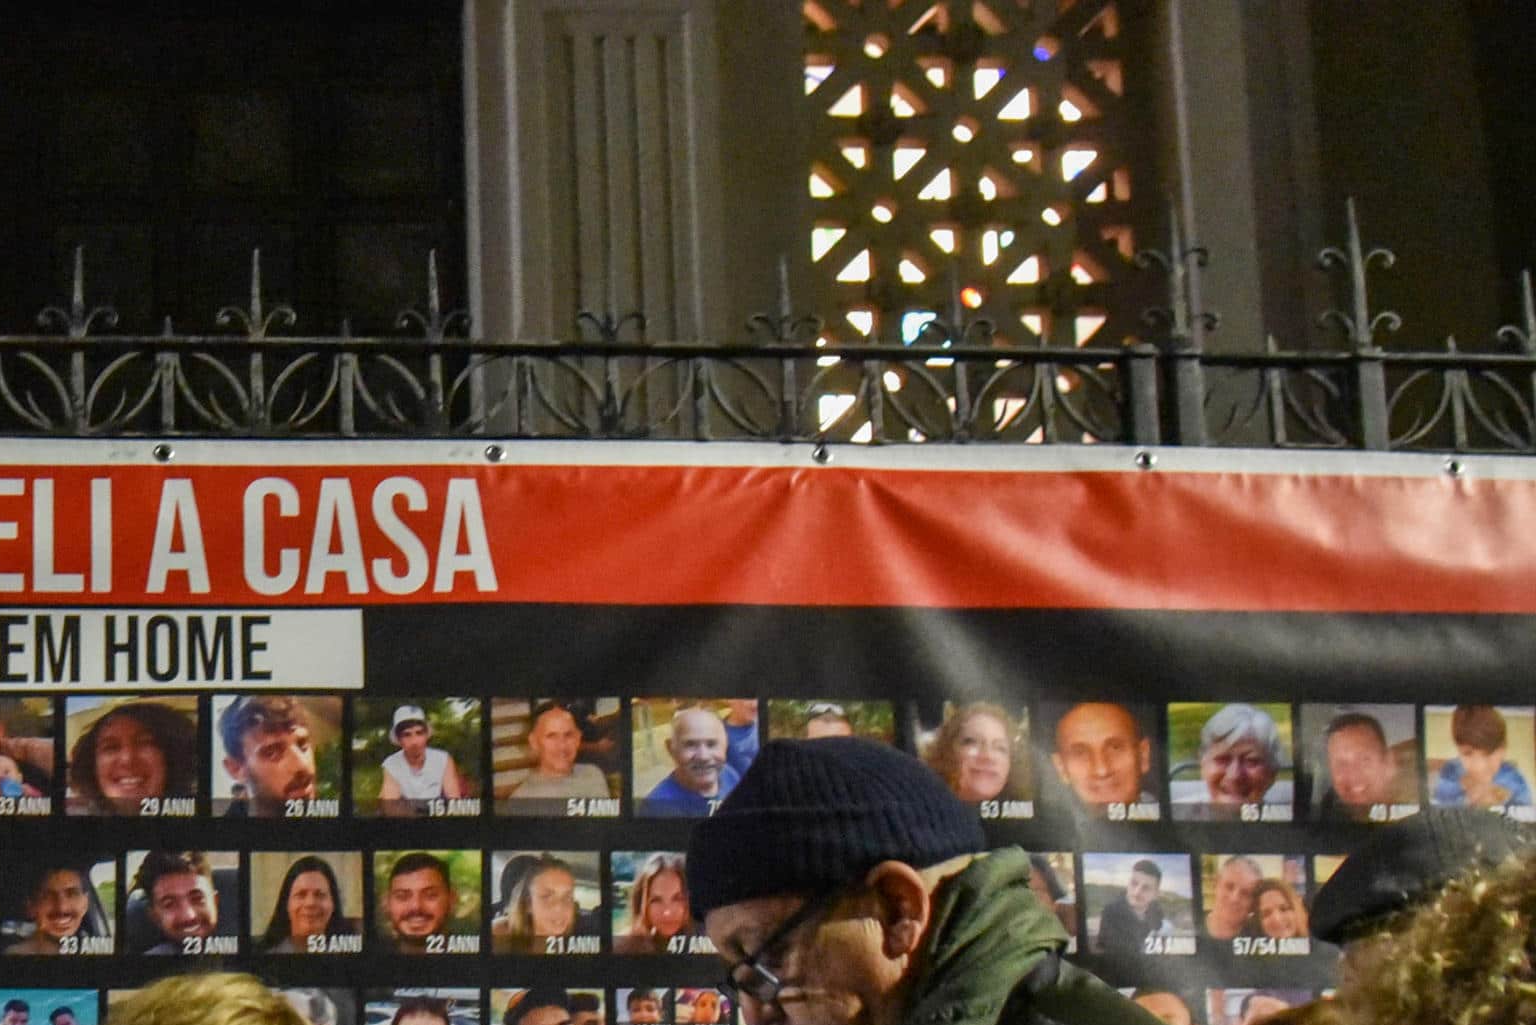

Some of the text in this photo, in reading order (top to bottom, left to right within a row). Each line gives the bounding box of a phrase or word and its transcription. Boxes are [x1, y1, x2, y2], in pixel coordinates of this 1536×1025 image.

[145, 477, 210, 594] A
[243, 476, 498, 595] CASA
[104, 614, 272, 681] HOME
[17, 797, 51, 815] ANNI
[140, 797, 195, 816] 29 ANNI
[285, 799, 339, 817] 26 ANNI
[446, 798, 480, 816] ANNI
[566, 798, 620, 817] 54 ANNI
[980, 800, 1034, 818] 53 ANNI
[1127, 802, 1160, 820] ANNI
[1260, 803, 1293, 821] ANNI
[59, 936, 114, 955] 33 ANNI
[183, 936, 238, 954] 23 ANNI
[307, 934, 362, 953] 53 ANNI
[426, 935, 480, 953] 22 ANNI
[546, 936, 600, 954] 21 ANNI
[667, 935, 720, 954] 47 ANN
[1164, 936, 1197, 954] ANNI
[1277, 937, 1311, 955] ANNI
